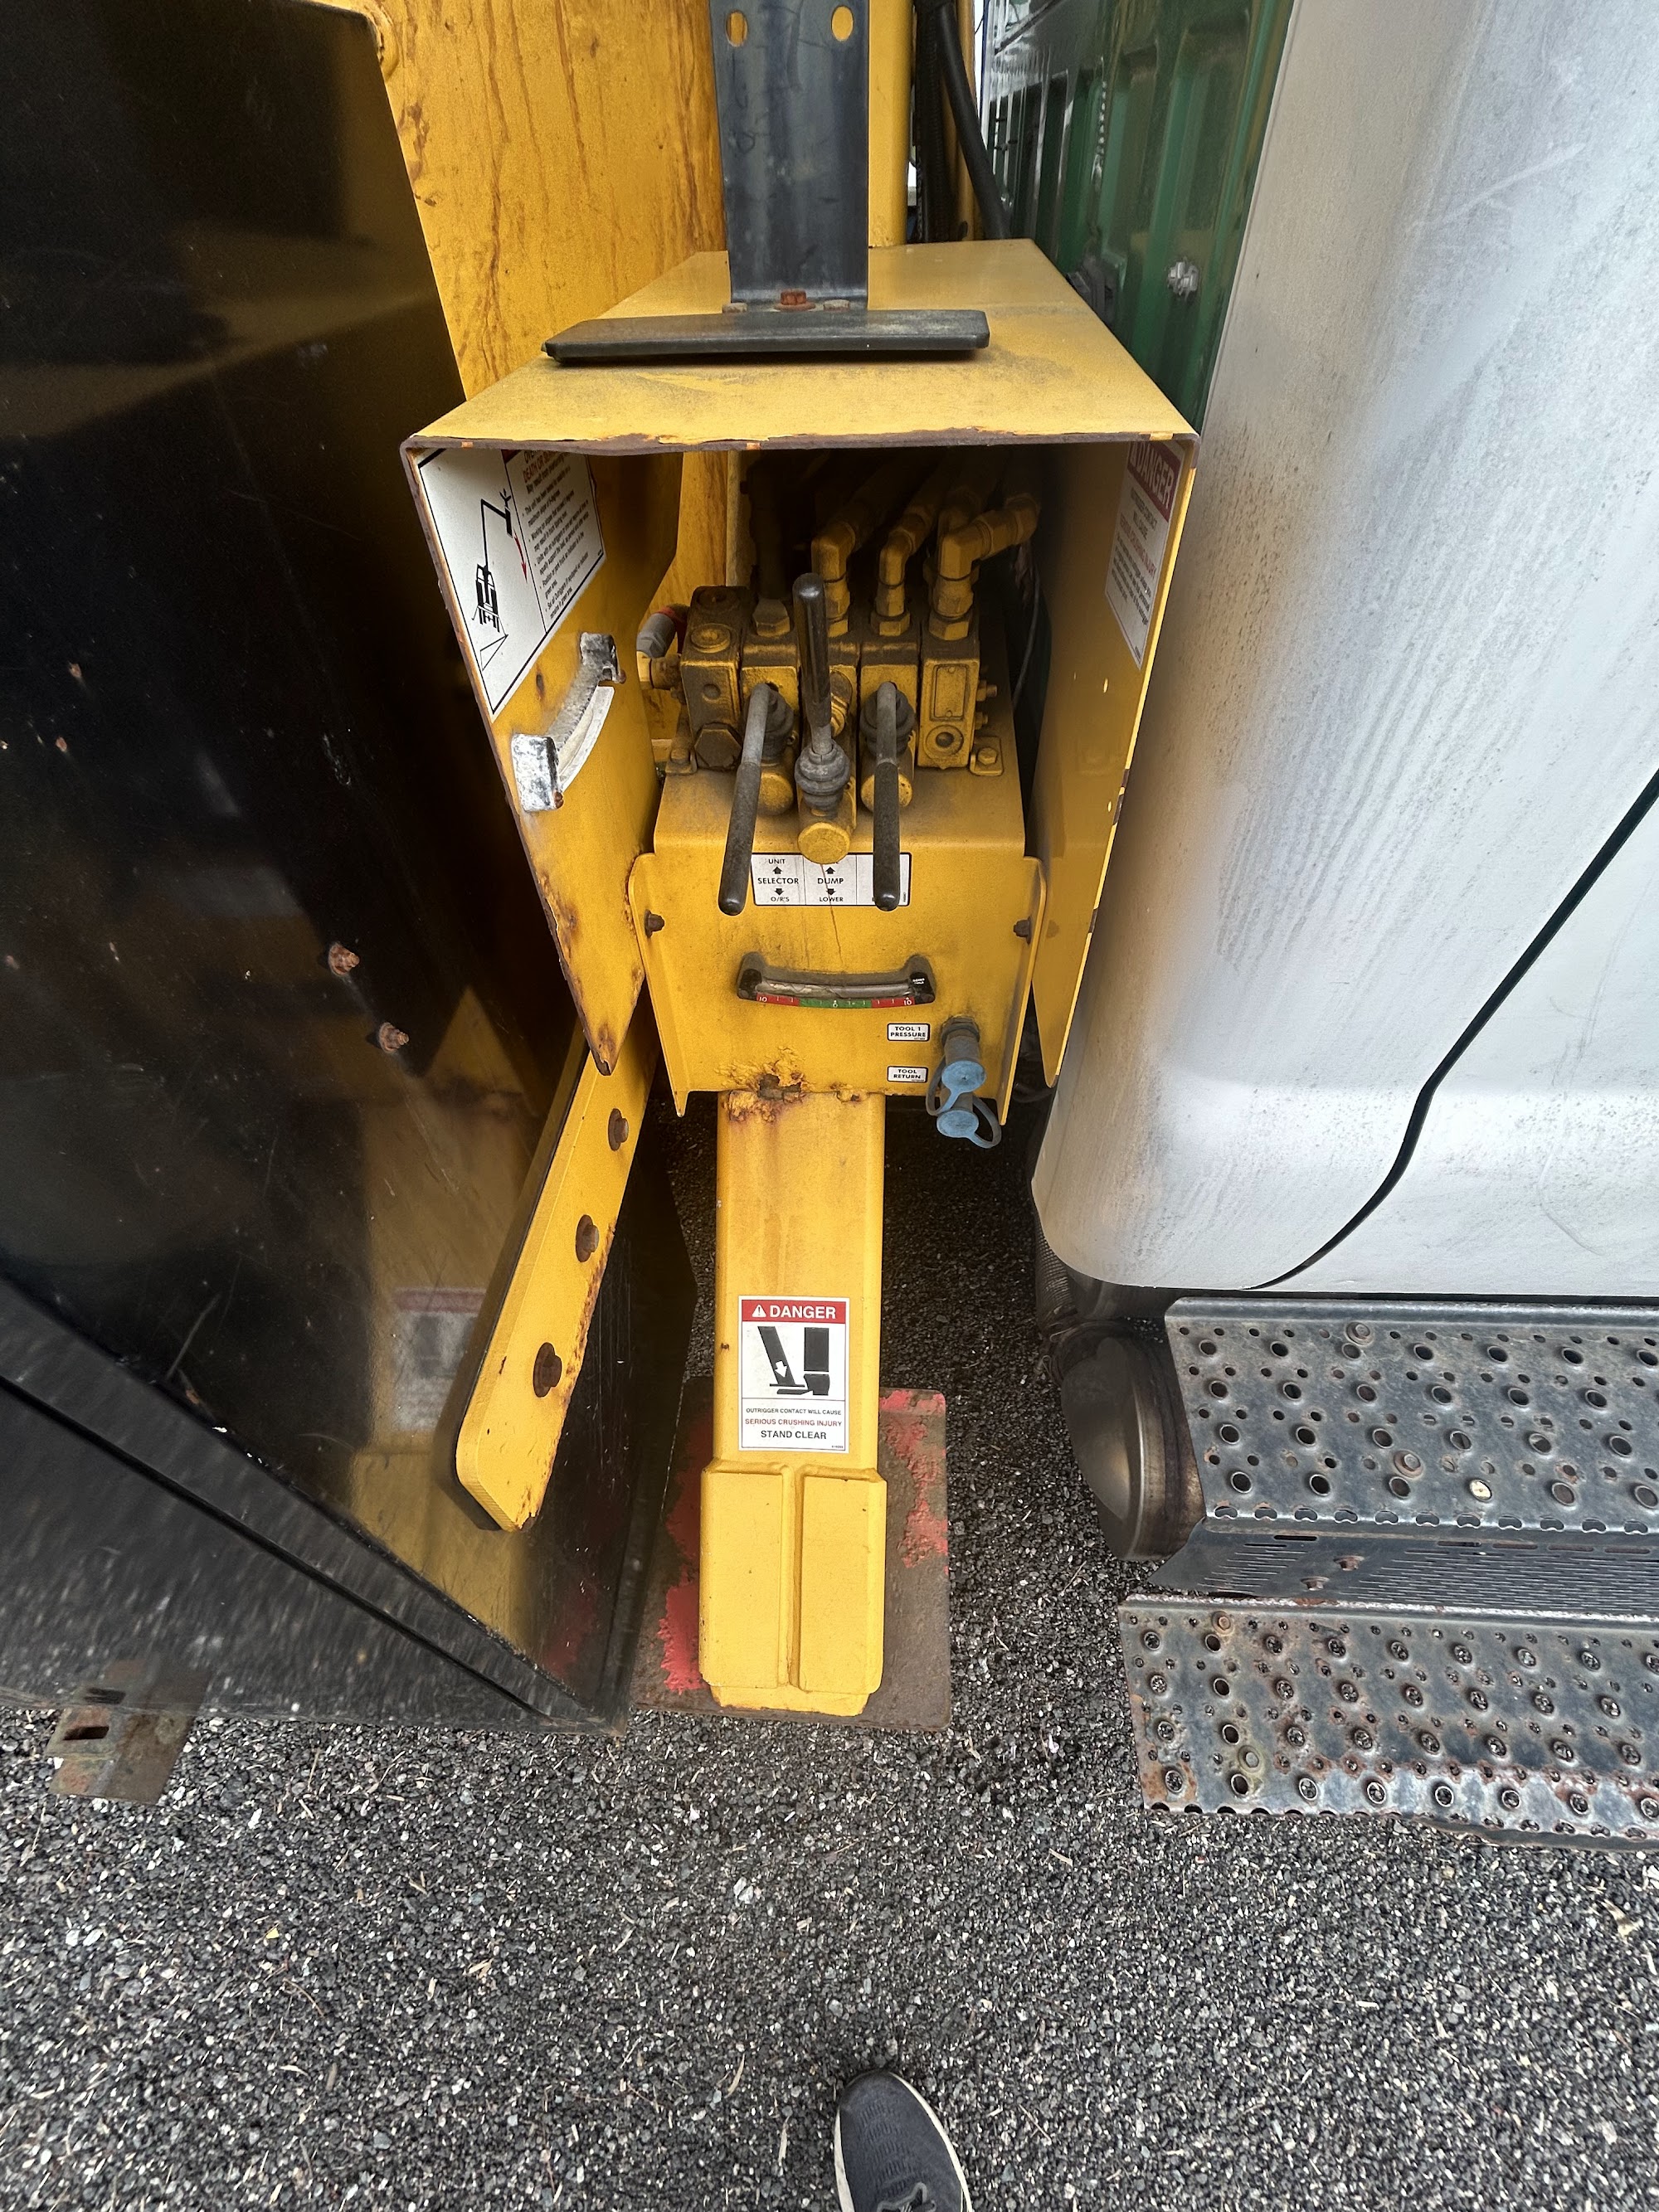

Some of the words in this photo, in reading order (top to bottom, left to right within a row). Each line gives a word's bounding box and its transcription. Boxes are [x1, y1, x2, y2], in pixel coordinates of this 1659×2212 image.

[1136, 441, 1174, 509] DANGER
[770, 1305, 836, 1320] DANGER
[761, 1430, 792, 1438] STAND
[795, 1431, 827, 1439] CLEAR
